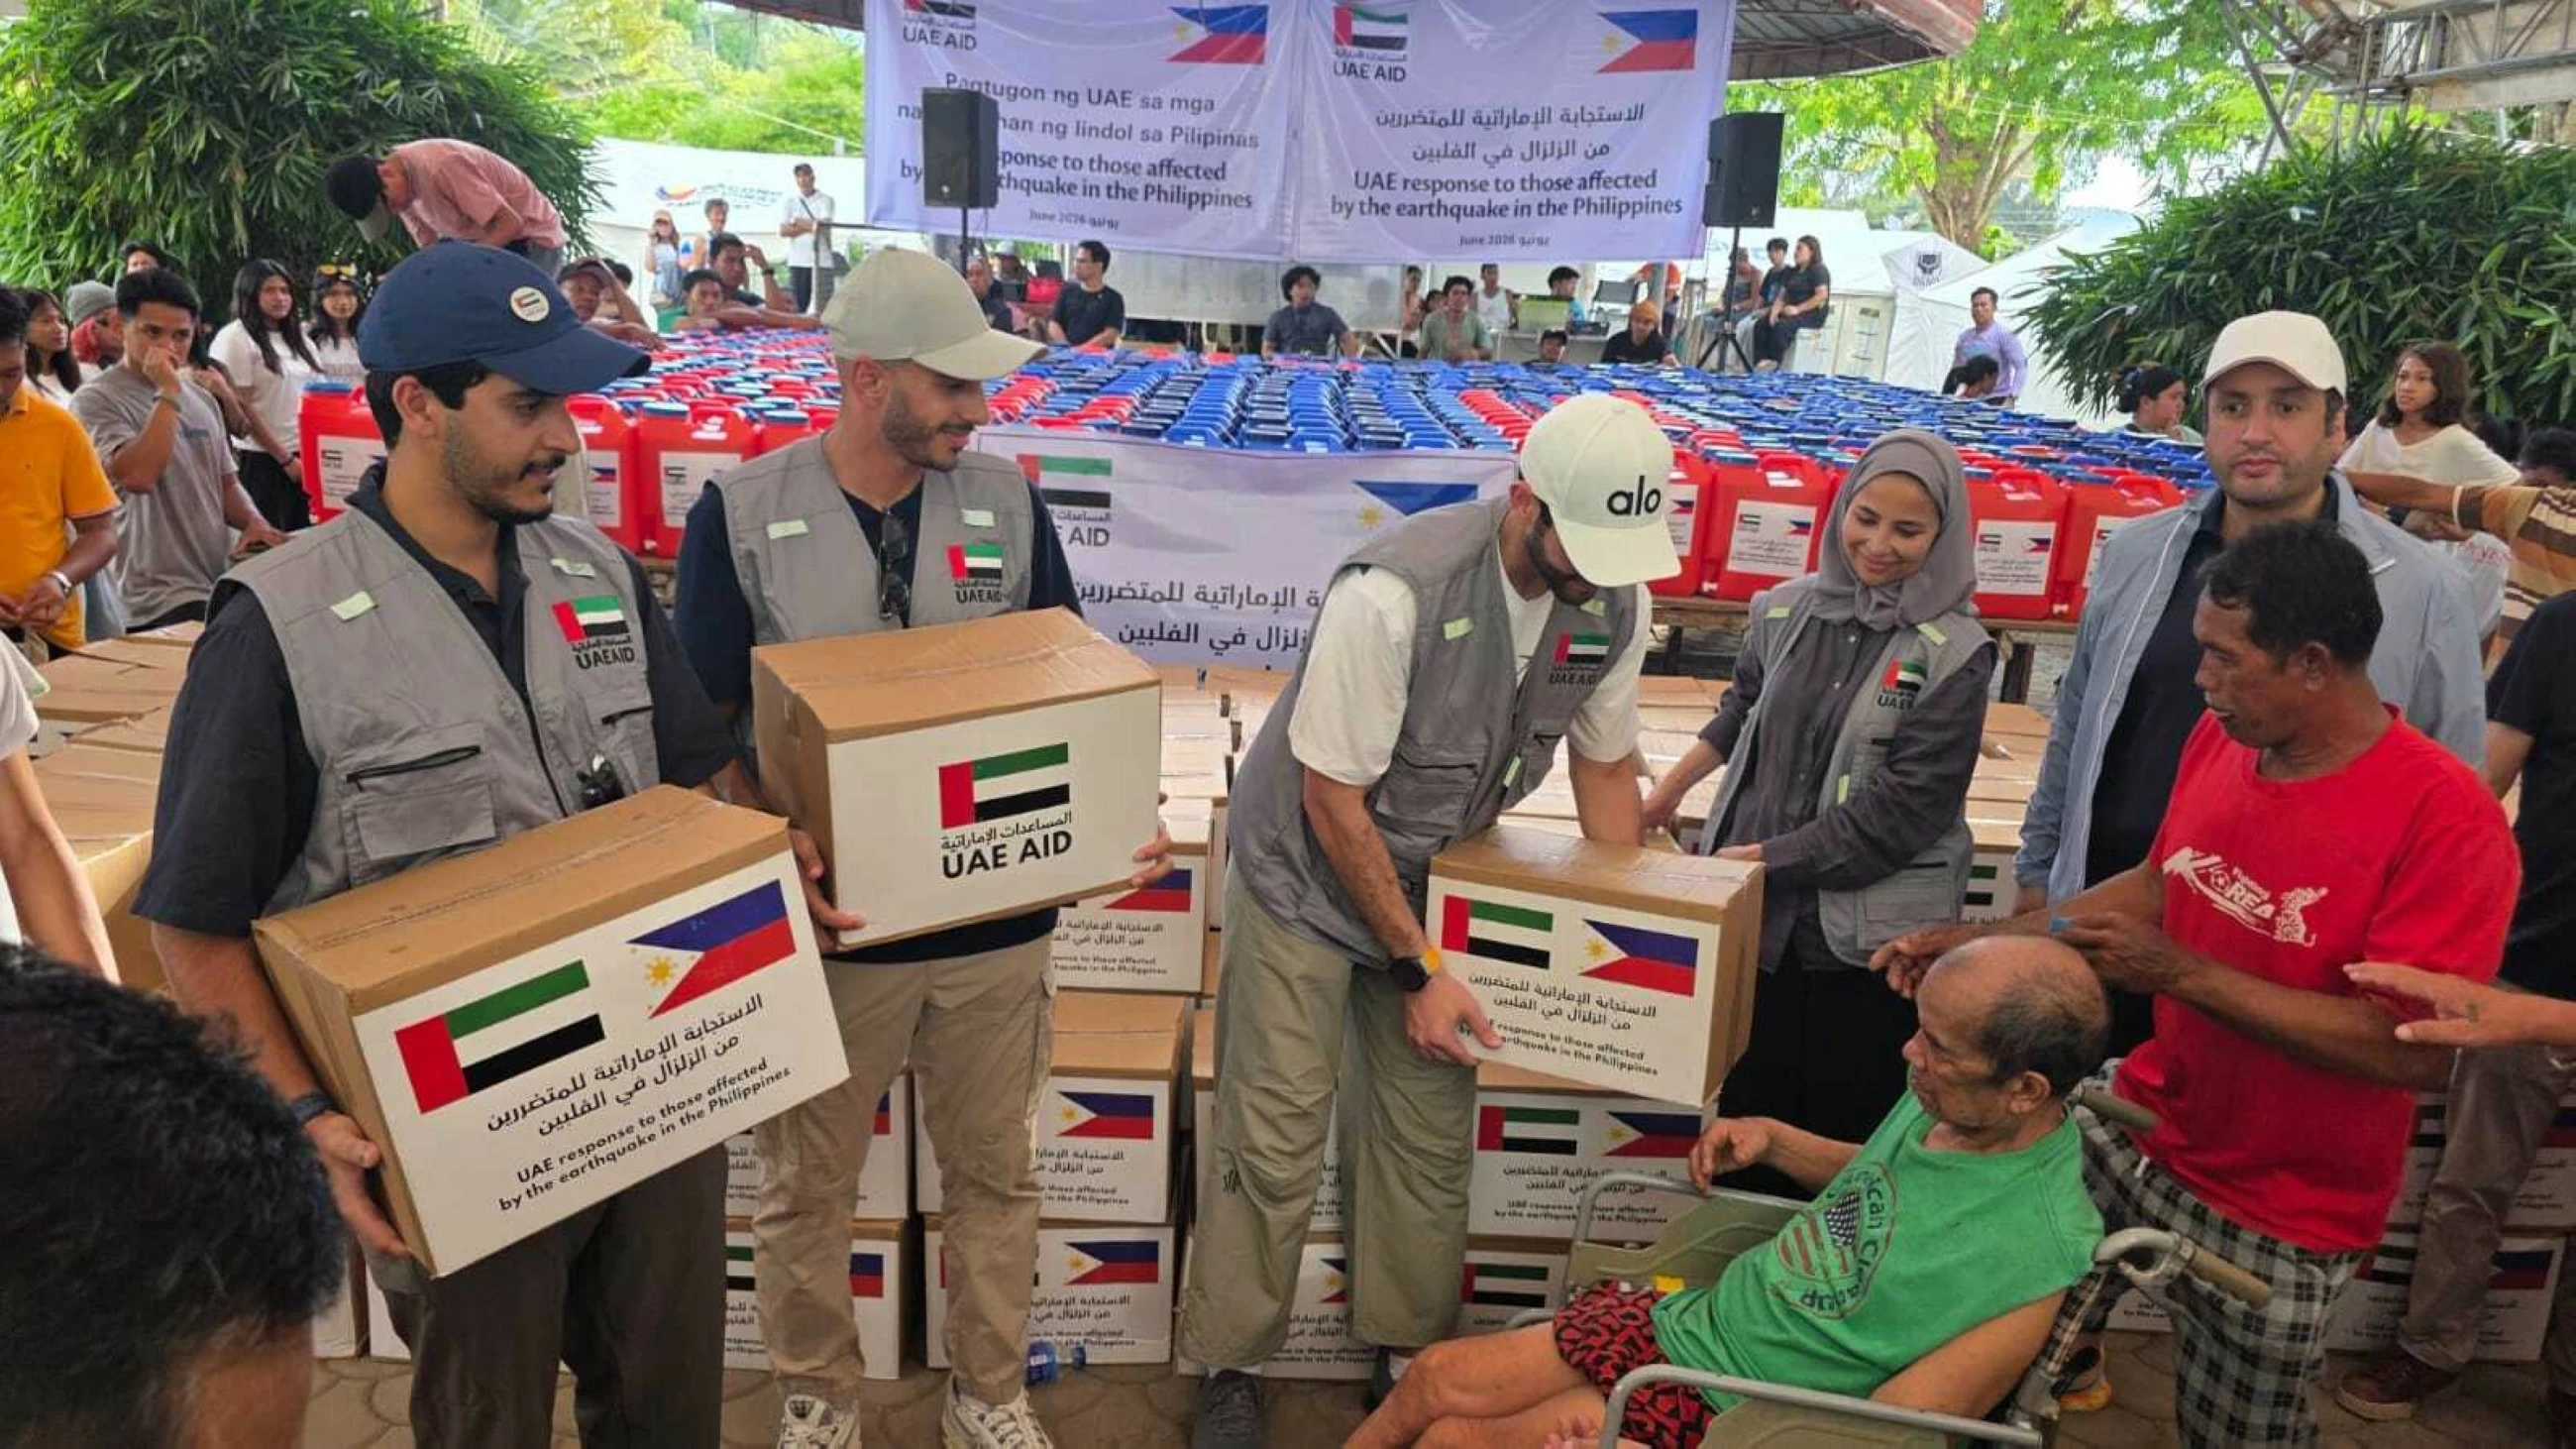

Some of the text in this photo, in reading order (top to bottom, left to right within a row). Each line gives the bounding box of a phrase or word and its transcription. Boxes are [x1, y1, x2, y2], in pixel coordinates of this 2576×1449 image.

[903, 25, 977, 52] UAE AID
[1333, 60, 1407, 82] UAE AID
[945, 71, 1217, 116] Pagtugon ng UAE sa mga
[1375, 103, 1645, 131] الاستجابة الإماراتية للمتضررين
[1041, 122, 1068, 141] ng
[1074, 119, 1133, 142] lindol
[1139, 127, 1164, 143] sa
[1170, 125, 1260, 149] Pilipinas
[1062, 154, 1084, 172] to
[1089, 153, 1143, 177] those
[1145, 157, 1228, 181] affected
[1412, 139, 1611, 169] من الزلزال في الفلبين
[900, 159, 923, 184] by
[1081, 178, 1101, 198] in
[1106, 179, 1139, 202] the
[1143, 183, 1254, 211] Philippines
[1352, 168, 1659, 198] UAE response to those affected
[1330, 194, 1684, 224] by the earthquake in the Philippines
[1606, 474, 1663, 516] alo
[1068, 526, 1111, 547] AID
[1194, 583, 1296, 614] الإماراتية
[1118, 619, 1200, 646] الفلبين
[1209, 626, 1246, 657] في
[942, 831, 1073, 879] UAE AID
[486, 991, 764, 1132] الاستجابة الإماراتية للمتضررين
[1594, 1053, 1660, 1076] Philippines
[1596, 1042, 1646, 1061] affected
[538, 1033, 740, 1137] من الزلزال في الفلبين
[516, 1056, 769, 1184] UAE response to those affected
[498, 1066, 793, 1212] by the earthquake in the Philippines
